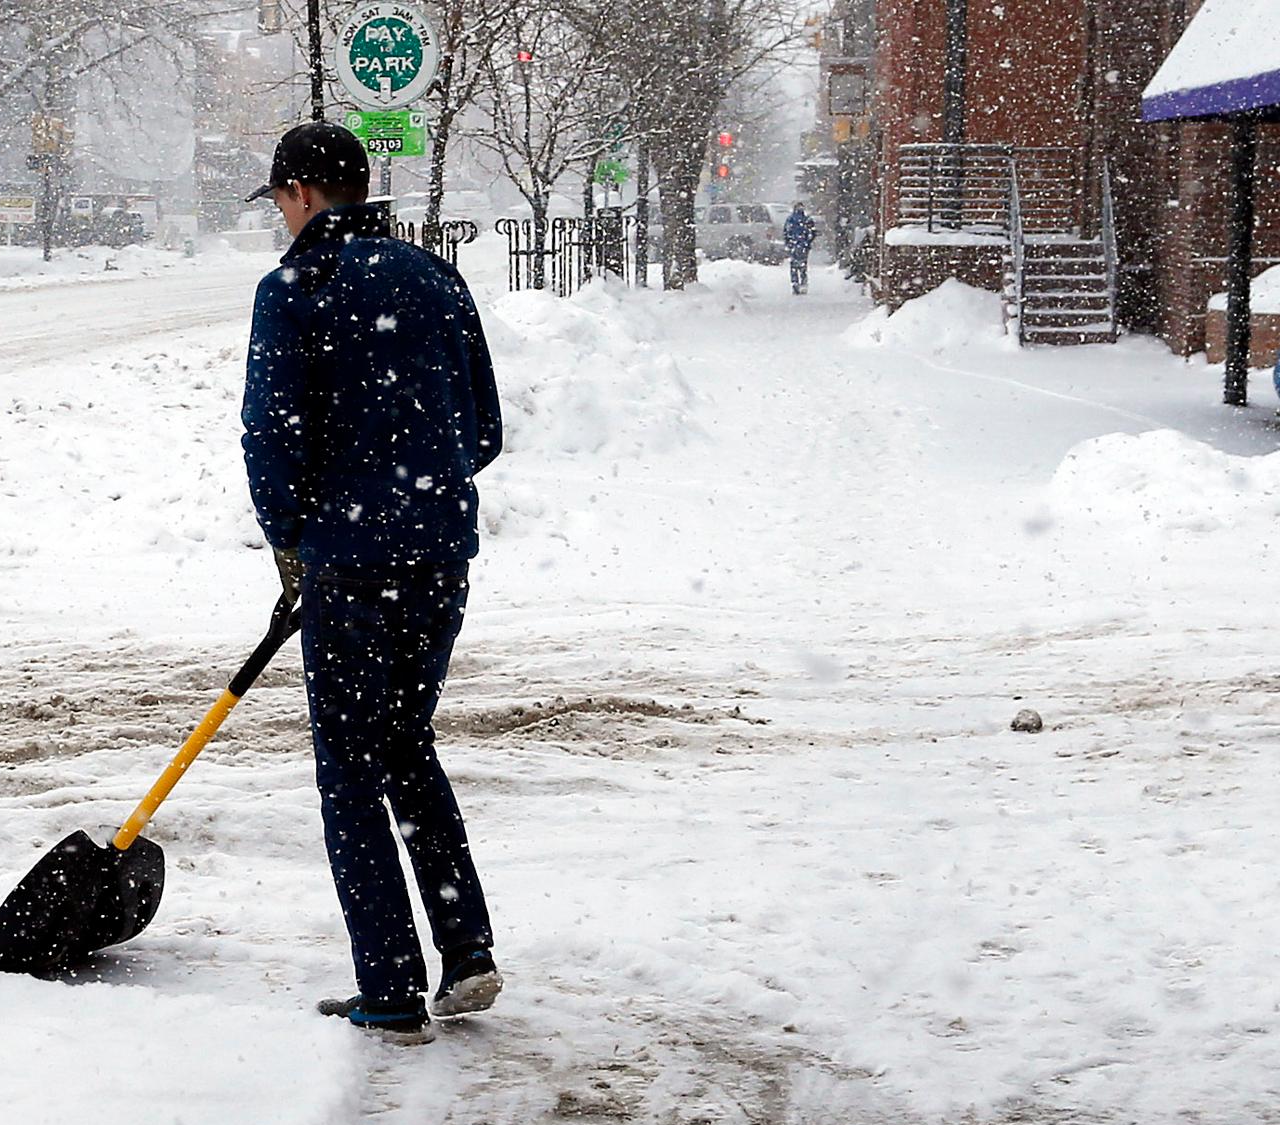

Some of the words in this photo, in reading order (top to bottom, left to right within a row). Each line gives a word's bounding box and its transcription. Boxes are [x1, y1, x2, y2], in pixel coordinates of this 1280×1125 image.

[343, 23, 359, 47] MON
[361, 7, 380, 21] SAT
[417, 23, 431, 47] 7PM
[365, 25, 408, 42] PAY
[355, 57, 416, 72] PARK
[368, 139, 402, 150] 95103
